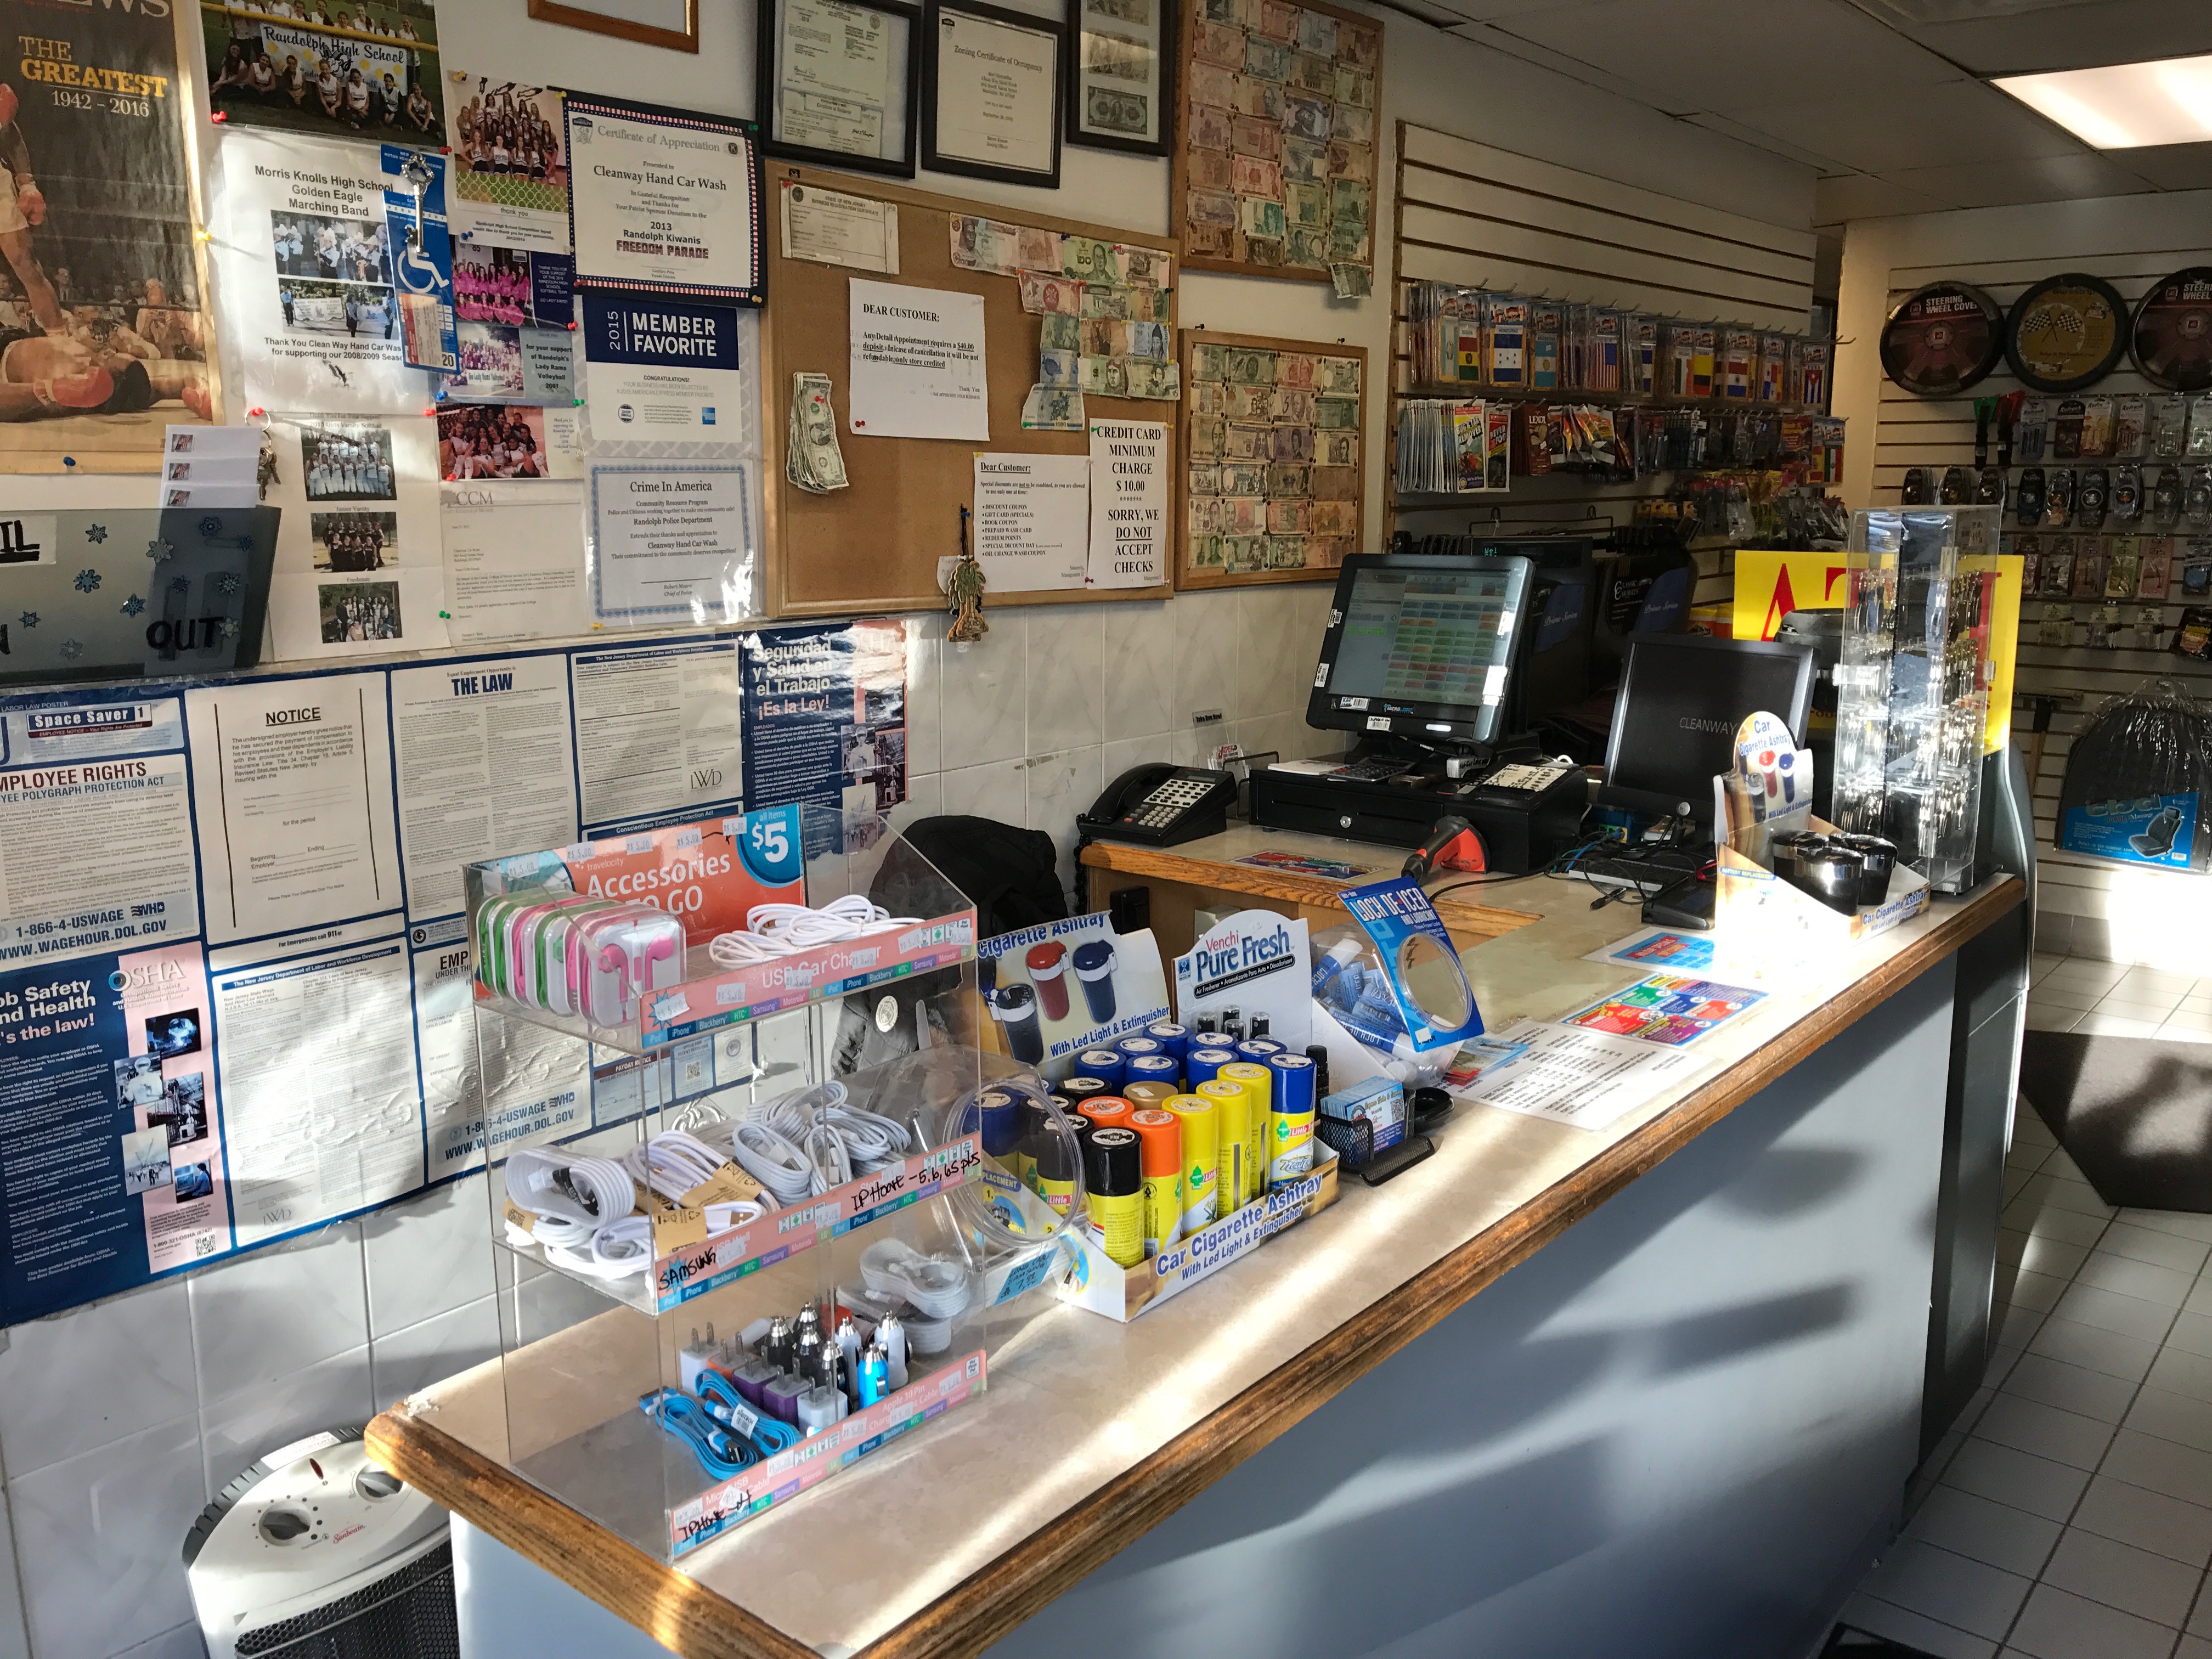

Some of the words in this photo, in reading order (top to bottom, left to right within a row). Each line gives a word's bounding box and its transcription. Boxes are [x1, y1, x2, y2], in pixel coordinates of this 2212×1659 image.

[19, 36, 71, 61] THE
[264, 26, 325, 52] Randolph
[331, 38, 360, 57] High
[364, 45, 404, 64] School
[955, 45, 975, 58] Zoning
[977, 50, 1005, 63] Certificate
[1014, 59, 1042, 73] Occupancy
[21, 59, 167, 97] GREATEST
[52, 90, 92, 110] 1942
[110, 98, 149, 117] 2016
[597, 125, 644, 142] Certificate
[647, 134, 657, 144] of
[659, 136, 720, 152] Appreciation
[255, 165, 290, 179] Morris
[294, 170, 328, 184] Knolls
[331, 176, 355, 188] High
[358, 179, 393, 192] School
[594, 165, 643, 184] Cleanway
[646, 172, 674, 185] Hand
[677, 176, 696, 187] Car
[698, 178, 726, 190] Wash
[292, 185, 330, 198] Golden
[334, 190, 363, 203] Eagle
[289, 198, 338, 215] Marching
[342, 205, 369, 216] Band
[650, 221, 672, 231] 2013
[623, 229, 663, 241] Randolph
[667, 234, 701, 245] Kiwanis
[616, 240, 663, 255] FREEDOM
[667, 245, 709, 259] PARADE
[1926, 295, 1963, 307] STEERING
[2183, 292, 2210, 300] WHEEL
[863, 303, 888, 315] DEAR
[890, 307, 940, 322] CUSTOMER:
[1926, 304, 1952, 314] WHEEL
[607, 311, 620, 351] 2015
[633, 312, 716, 336] MEMBER
[876, 333, 893, 341] Detail
[895, 336, 929, 346] Appointment
[931, 340, 951, 348] requires
[264, 338, 289, 346] Thank
[291, 338, 307, 347] You
[309, 339, 330, 348] Clean
[332, 341, 348, 351] Way
[351, 342, 369, 351] Hand
[634, 335, 716, 357] FAVORITE
[285, 349, 327, 359] supporting
[343, 351, 380, 360] 2008/2009
[442, 353, 454, 367] 20
[644, 375, 690, 383] CONGRATULATIONS!
[1097, 426, 1134, 438] CREDIT
[1136, 428, 1161, 440] CARD
[1109, 444, 1155, 457] MINIMUM
[980, 462, 997, 471] Dear
[998, 462, 1031, 473] Customer:
[1112, 462, 1153, 475] CHARGE
[630, 481, 659, 493] Crime
[662, 481, 672, 492] In
[674, 480, 712, 491] America
[1124, 481, 1145, 492] 10.00
[456, 490, 494, 507] CCM
[634, 517, 661, 526] Randolph
[681, 516, 713, 525] Department
[1108, 509, 1143, 521] SORRY,
[1146, 510, 1159, 520] WE
[1116, 527, 1131, 539] DO
[1133, 527, 1152, 538] NOT
[648, 541, 675, 550] Cleanway
[1115, 544, 1153, 556] ACCEPT
[1114, 561, 1153, 573] CHECKS
[146, 616, 224, 651] OUT
[754, 639, 831, 662] Seguridad
[753, 667, 761, 682] y
[766, 661, 811, 678] Salud
[815, 659, 832, 672] en
[452, 677, 478, 696] THE
[482, 673, 512, 692] LAW
[756, 683, 770, 696] el
[775, 676, 830, 695] Trabajo
[785, 699, 797, 713] la
[800, 695, 830, 712] Ley!
[35, 713, 81, 728] Space
[87, 709, 128, 723] Saver
[137, 707, 143, 718] 1
[266, 707, 321, 724] NOTICE
[1679, 717, 1737, 735] CLEANWAY
[1754, 720, 1770, 733] Car
[1740, 738, 1767, 756] Cigarette
[1769, 733, 1790, 747] Ashtray
[83, 761, 146, 782] RIGHTS
[22, 786, 81, 802] POLYGRAPH
[84, 780, 144, 793] PROTECTION
[147, 776, 164, 786] ACT
[759, 812, 767, 821] all
[768, 810, 786, 820] items
[586, 858, 624, 872] travelocity
[1722, 867, 1741, 876] BATTERY
[1742, 871, 1774, 880] REPLACEMENT
[587, 853, 731, 900] Accessories
[667, 885, 703, 915] GO
[1349, 896, 1389, 922] LOCK
[1863, 914, 1874, 925] Car
[1876, 900, 1904, 919] Cigarette
[1905, 890, 1926, 906] Ashtray
[16, 909, 124, 938] 1-866-4-USWAGE
[1206, 929, 1239, 953] Venchi
[1196, 947, 1239, 983] Pure
[1242, 924, 1290, 967] Fresh
[25, 980, 91, 1002] Safety
[30, 995, 96, 1018] Health
[19, 1023, 52, 1041] the
[55, 1013, 95, 1033] law!
[672, 1027, 690, 1037] iPhone
[734, 1011, 744, 1020] HTC
[753, 1003, 775, 1015] Samsung
[1049, 1042, 1070, 1057] With
[1073, 1035, 1088, 1050] Led
[1090, 1025, 1111, 1043] Light
[1113, 1023, 1119, 1035] &
[1122, 1006, 1170, 1032] Extinguisher
[1157, 1248, 1187, 1276] Car
[1191, 1207, 1263, 1256] Cigarette
[1267, 1173, 1322, 1215] Ashtray
[1182, 1259, 1201, 1280] With
[1204, 1252, 1219, 1268] Led
[1222, 1237, 1242, 1259] Light
[1245, 1233, 1250, 1245] &
[1254, 1205, 1302, 1241] Extinguisher
